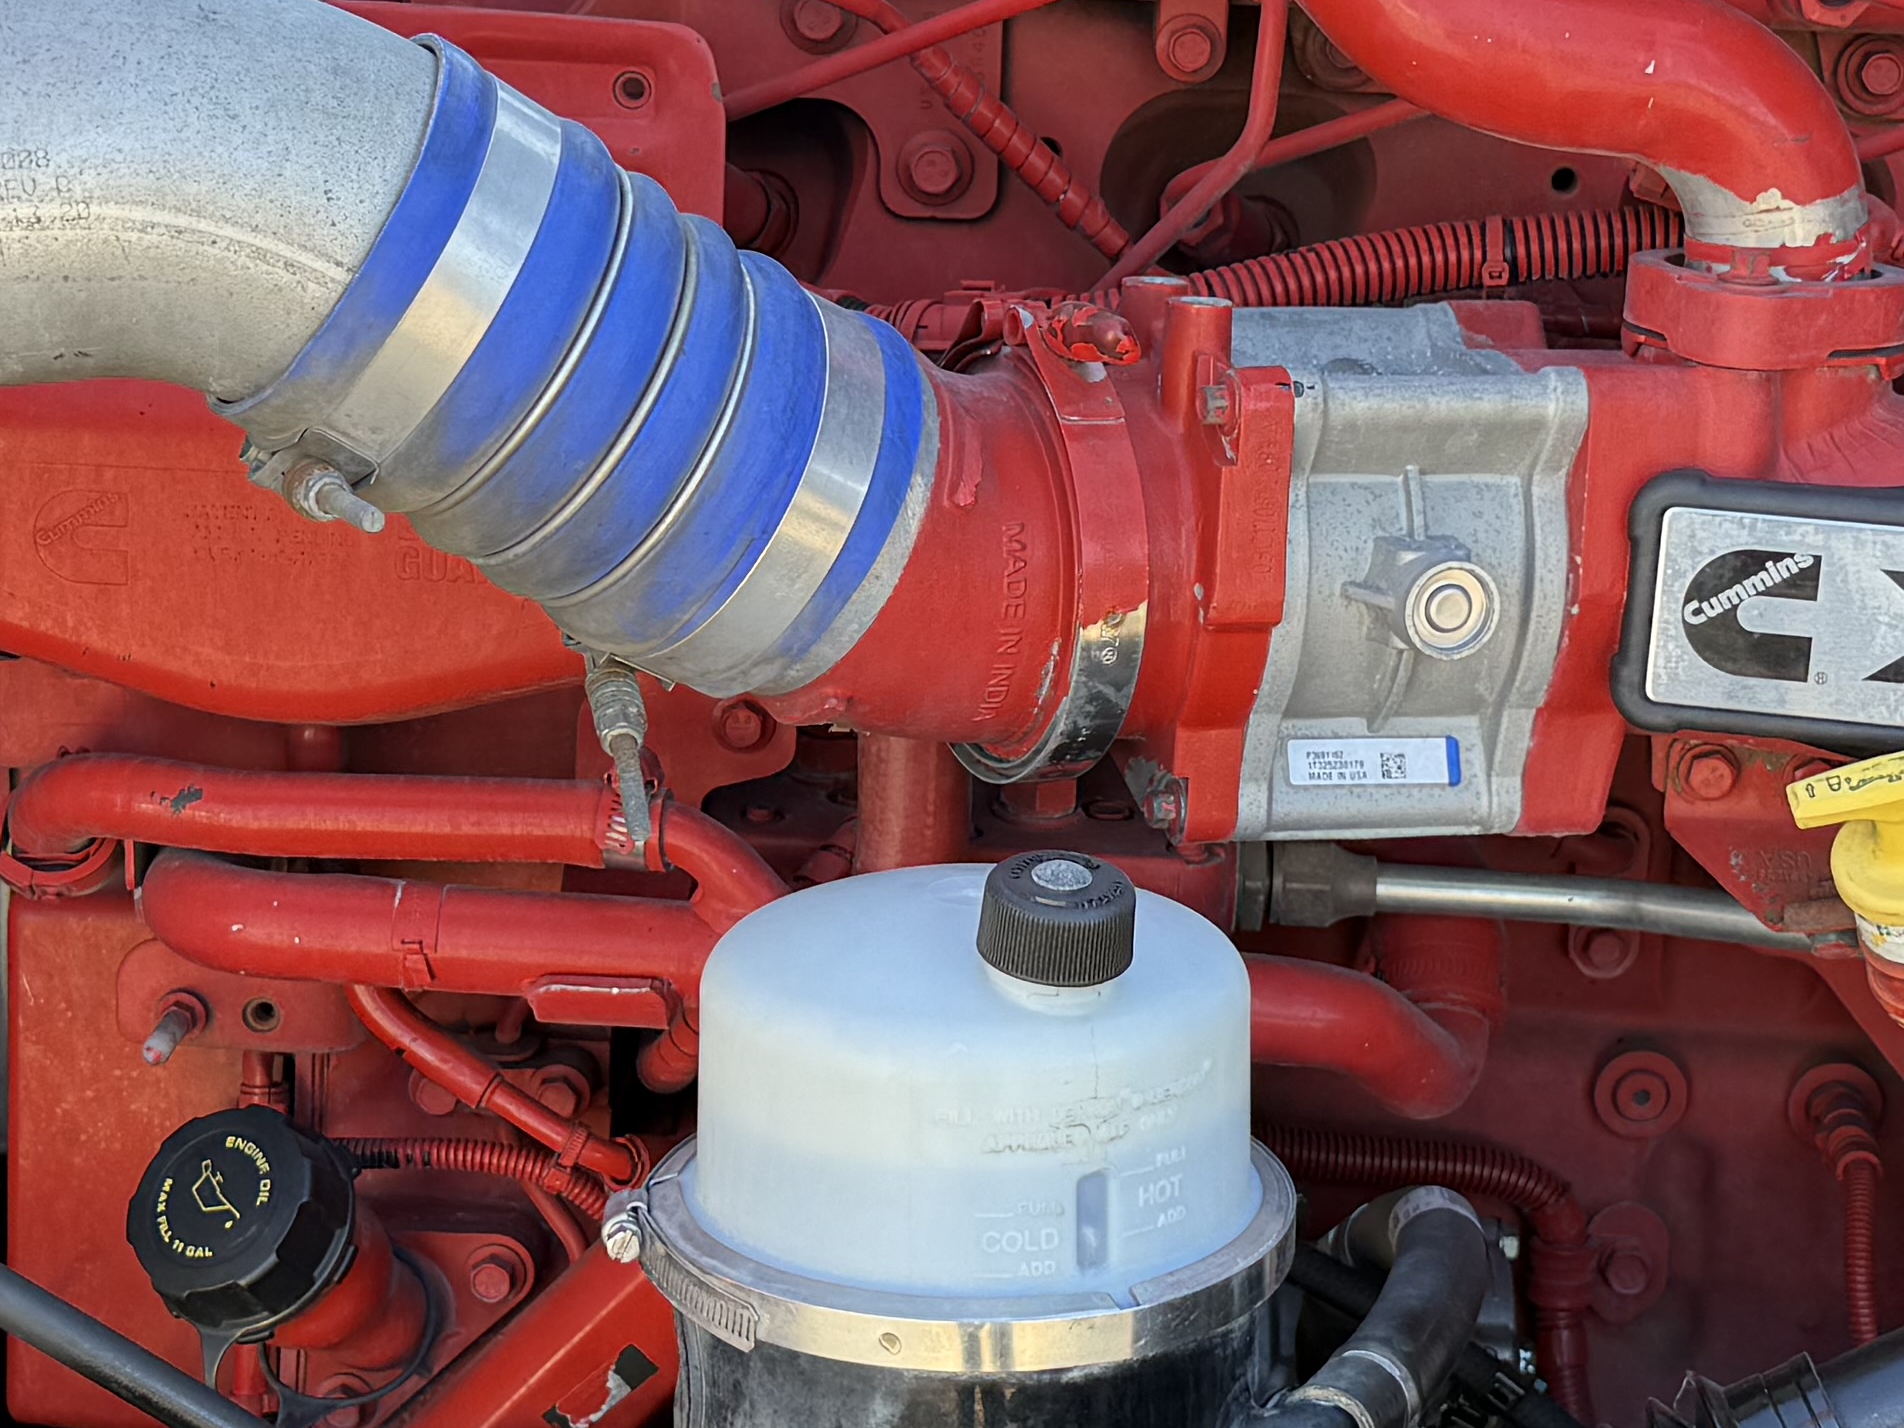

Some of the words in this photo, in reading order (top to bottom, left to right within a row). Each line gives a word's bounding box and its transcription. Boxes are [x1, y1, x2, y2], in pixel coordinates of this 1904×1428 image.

[395, 546, 488, 584] GUA
[1002, 522, 1027, 620] MADE
[1682, 550, 1816, 627] Cummins
[996, 628, 1024, 656] IN
[972, 662, 1015, 722] INDIA
[225, 1135, 271, 1175] ENGINE
[256, 1178, 271, 1207] OIL
[156, 1178, 173, 1213] MAX
[1138, 1174, 1184, 1207] HOT
[156, 1215, 173, 1243] FILL
[1158, 1205, 1187, 1228] ADD
[172, 1239, 184, 1253] 11
[186, 1246, 213, 1259] GAL
[982, 1228, 1060, 1253] COLD
[1019, 1261, 1056, 1278] ADD
